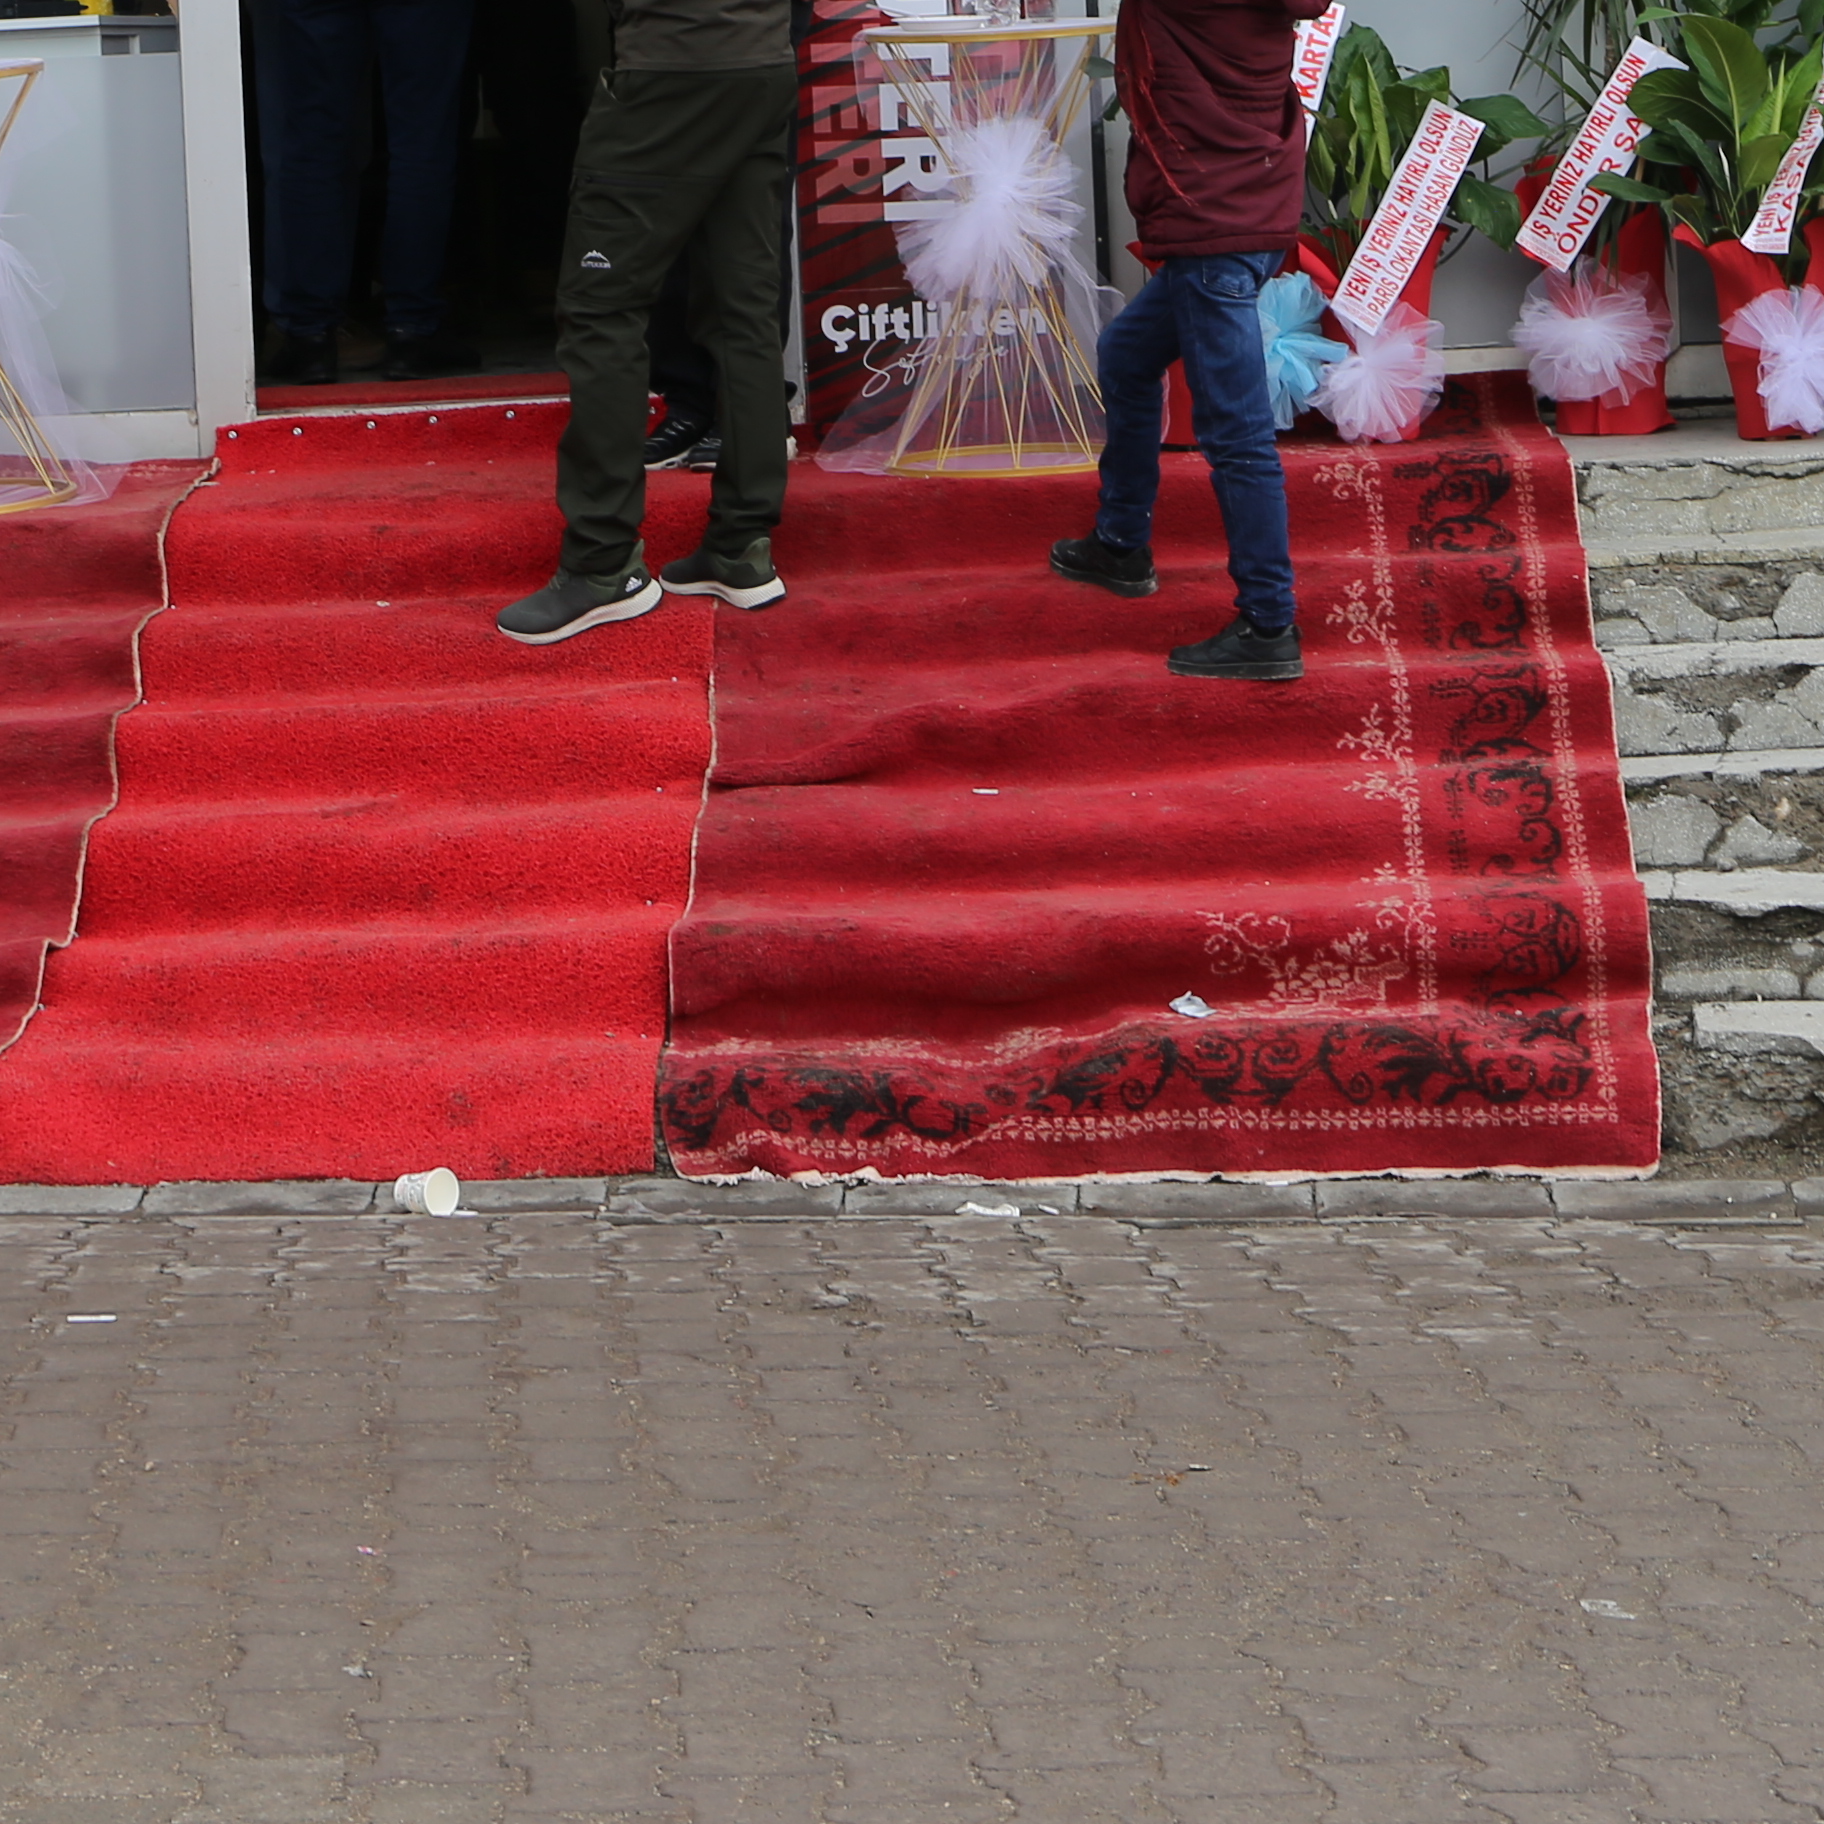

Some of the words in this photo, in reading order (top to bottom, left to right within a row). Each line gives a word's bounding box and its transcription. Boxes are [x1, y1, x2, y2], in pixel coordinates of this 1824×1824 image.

[1393, 152, 1432, 208] HAYIRLI
[1419, 108, 1455, 155] OLSUN
[1420, 168, 1456, 218] HASAN
[1439, 119, 1480, 174] GÜNDÜZ
[1571, 101, 1619, 166] HAYIRLI
